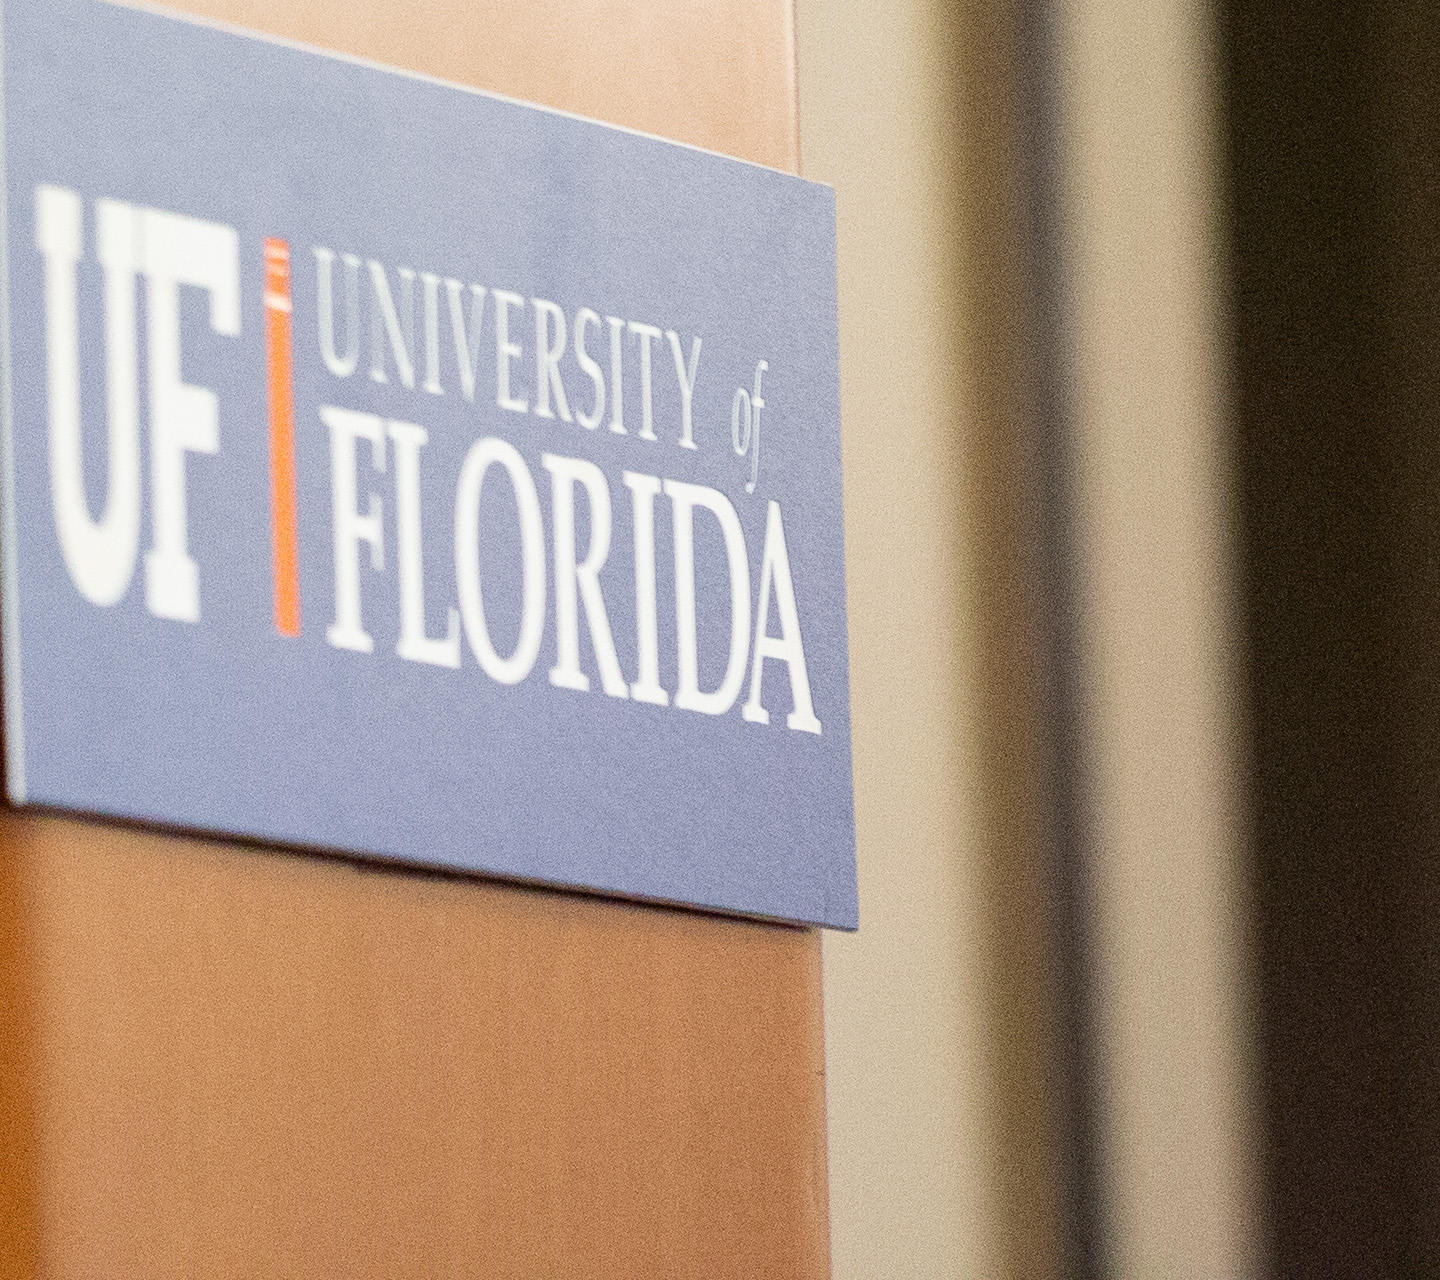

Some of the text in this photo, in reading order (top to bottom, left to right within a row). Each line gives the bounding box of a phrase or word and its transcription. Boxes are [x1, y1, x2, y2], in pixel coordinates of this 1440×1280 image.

[35, 184, 242, 624] UF
[312, 246, 769, 493] UNIVERSITY of
[318, 405, 823, 736] FLORIDA
